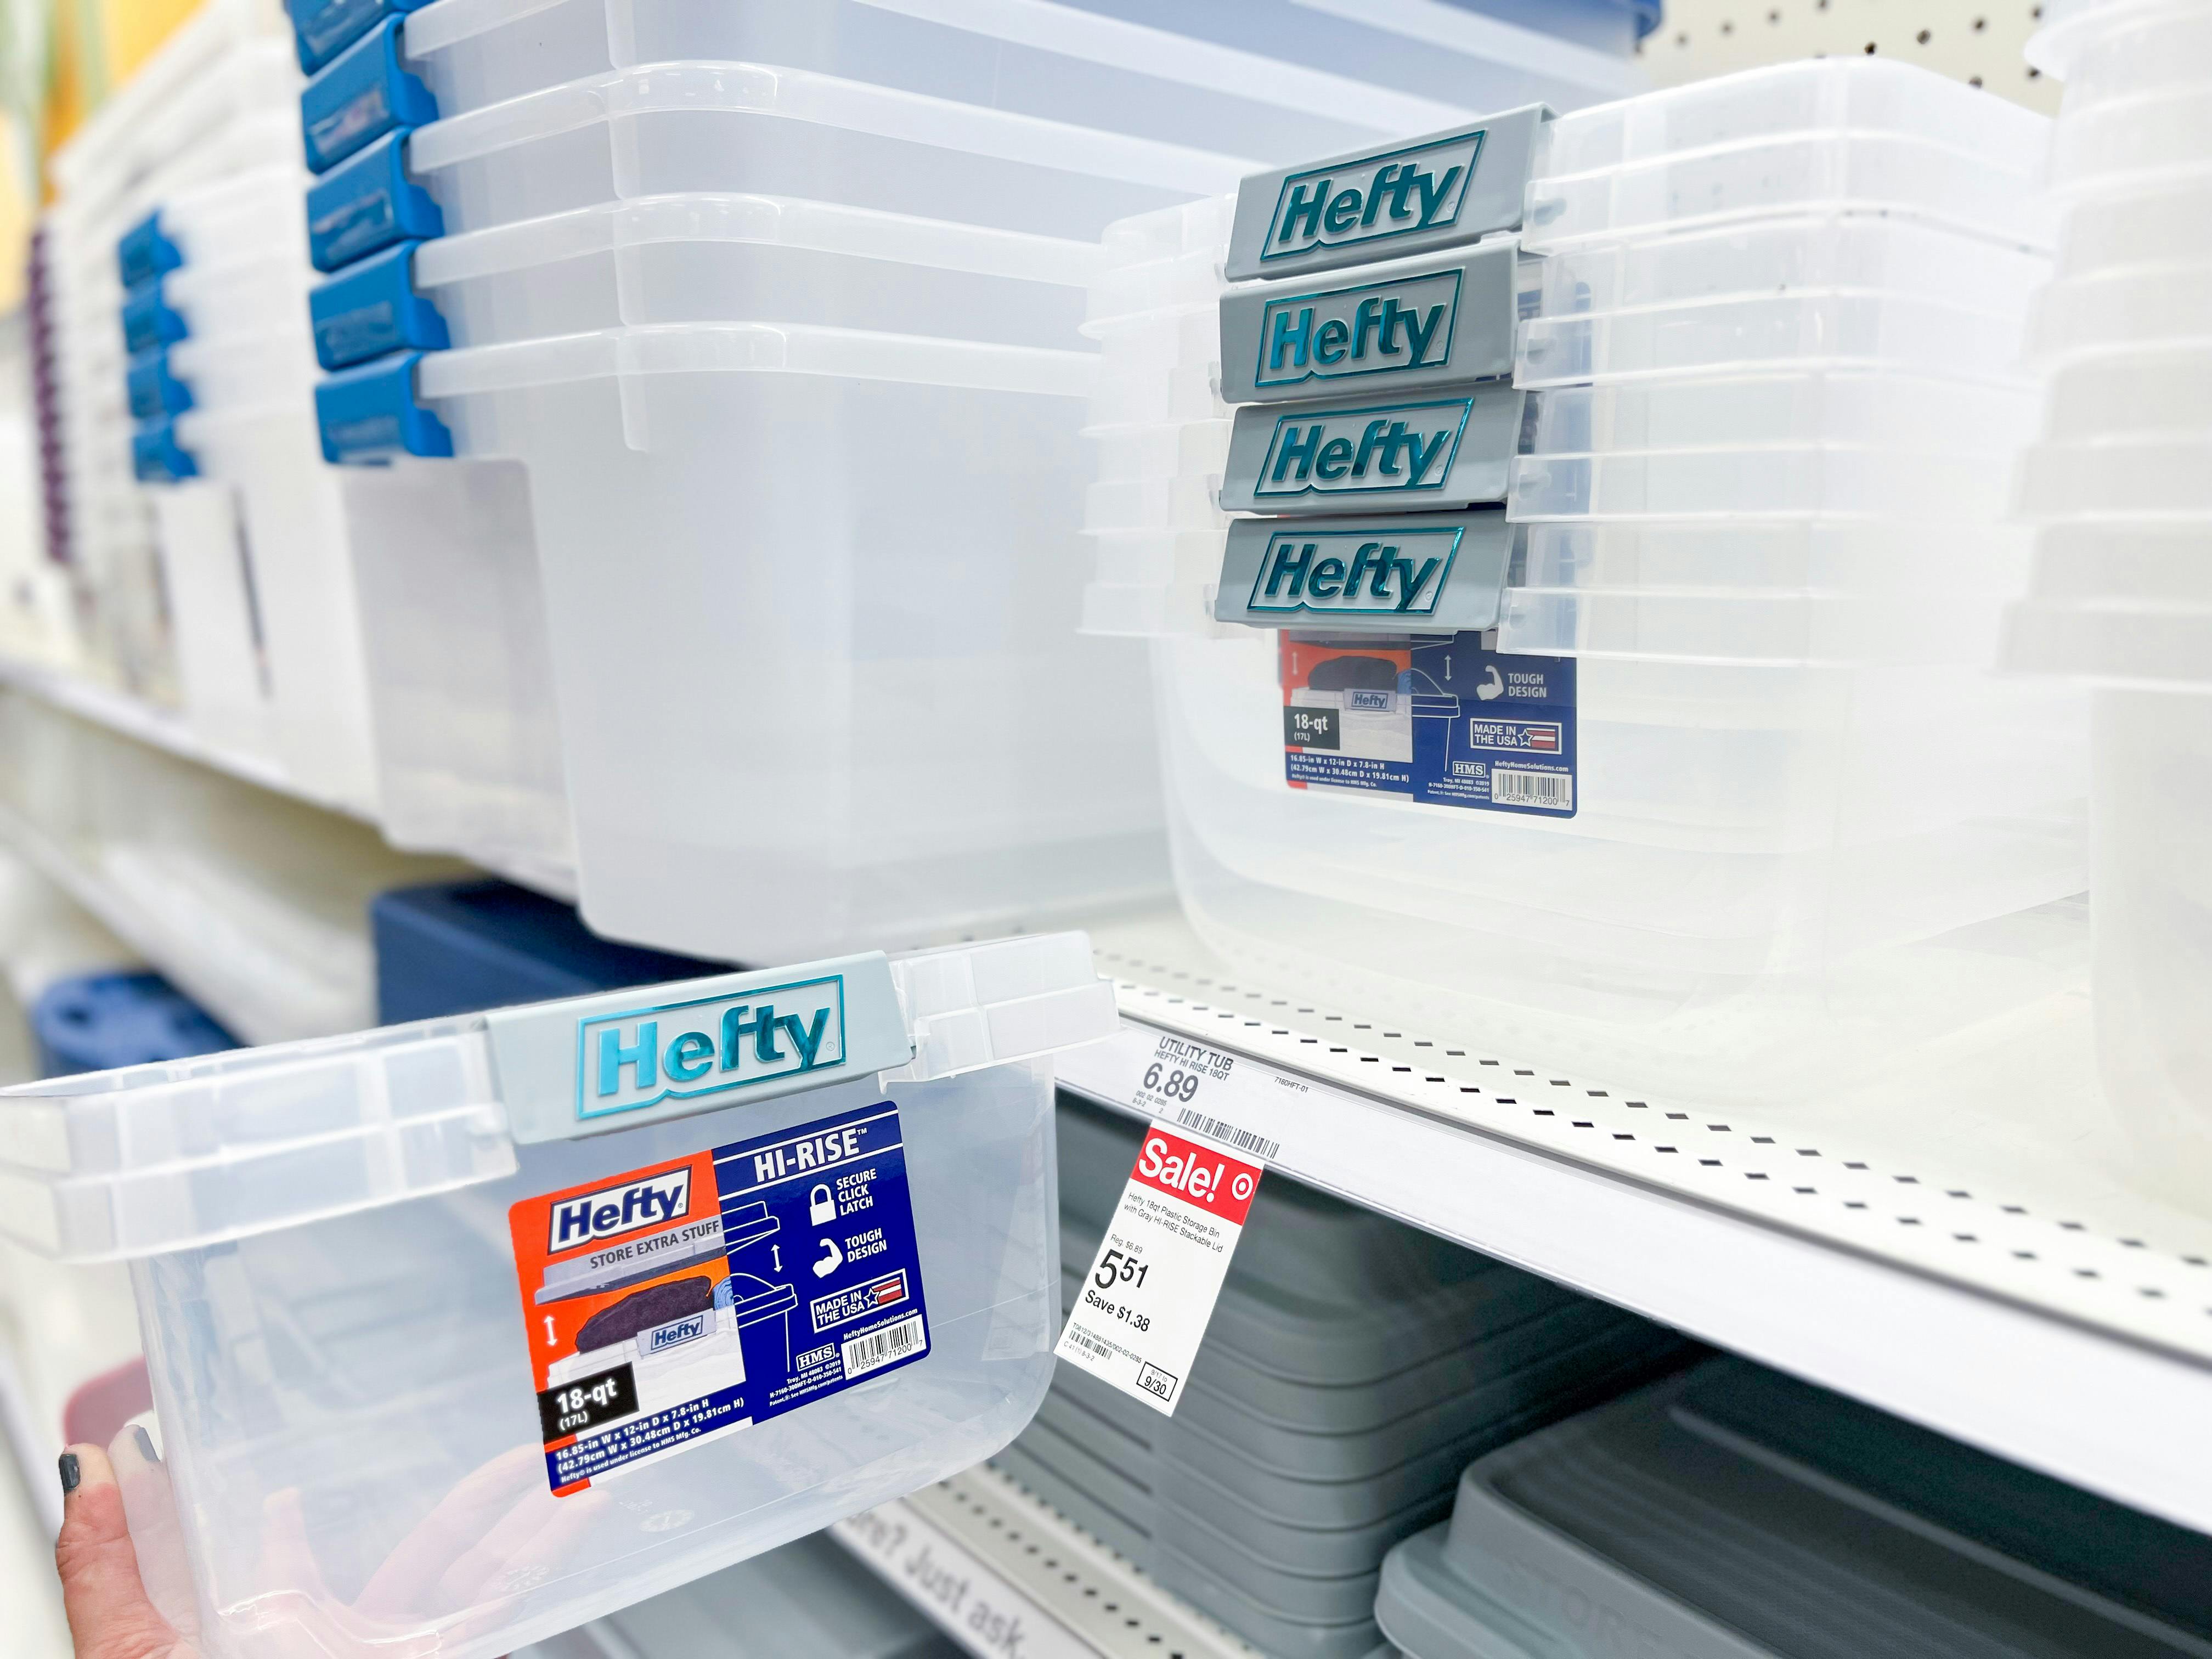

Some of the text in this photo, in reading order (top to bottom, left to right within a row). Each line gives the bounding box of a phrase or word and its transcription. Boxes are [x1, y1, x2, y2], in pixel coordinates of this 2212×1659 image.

[1278, 162, 1465, 242] Hefty
[1269, 295, 1447, 369] Hefty
[1271, 419, 1452, 487] Hefty
[1264, 542, 1442, 610] Hefty
[1508, 673, 1544, 685] TOUGH
[1353, 693, 1386, 709] Hefty
[1508, 686, 1547, 698] DESIGN
[1294, 714, 1328, 733] 18-qt
[1474, 724, 1516, 737] MADE IN
[1294, 732, 1311, 742] (17L)
[1475, 734, 1517, 747] THE USA
[1290, 755, 1314, 763] 16.85-in
[1454, 764, 1483, 776] HMS
[1494, 760, 1568, 772] HeftyHomeSolutions.com
[1291, 764, 1317, 772] (42.79cm
[1332, 768, 1357, 777] 30.48cm
[1373, 772, 1399, 781] 19.81cm
[1402, 775, 1409, 783] H)
[1507, 793, 1530, 803] 25947
[1533, 795, 1558, 806] 71200
[599, 1005, 830, 1097] Hefty
[1159, 1036, 1234, 1071] UTILITY TUB
[1154, 1049, 1229, 1081] HEFTY HI RISE 18QT
[1143, 1063, 1199, 1103] 6.89
[1274, 1076, 1308, 1093] 7160HFT-01
[836, 1168, 877, 1190] SECURE
[1138, 1137, 1225, 1203] Sale!
[838, 1183, 869, 1203] CLICK
[558, 1184, 684, 1243] Hefty
[839, 1196, 873, 1216] LATCH
[1128, 1192, 1220, 1238] Hefty 18qt Plastic Storage Bin
[844, 1228, 882, 1250] TOUGH
[1124, 1203, 1224, 1252] with Gray HI-RISE Stackable Lid
[590, 1220, 720, 1269] STORE EXTRA STUFF
[847, 1239, 887, 1263] DESIGN
[1110, 1233, 1143, 1255] Reg. $6.89
[816, 1290, 862, 1315] MADE IN
[817, 1301, 865, 1327] THE USA
[1085, 1290, 1150, 1333] Save $1.38
[654, 1320, 700, 1347] Hefty
[843, 1308, 918, 1341] HeftyHomeSolutions.com
[798, 1346, 833, 1368] HMS
[860, 1354, 884, 1369] 25947
[888, 1342, 912, 1361] 71200
[787, 1376, 800, 1384] Troy,
[1144, 1375, 1166, 1395] 9/30
[557, 1378, 617, 1414] 18-qt
[556, 1440, 599, 1461] 16.85-in
[602, 1434, 611, 1444] W
[624, 1421, 650, 1437] 12-in
[652, 1417, 659, 1426] D
[672, 1404, 700, 1420] 7.8-in
[702, 1398, 709, 1408] H
[559, 1411, 588, 1431] (17L)
[557, 1451, 605, 1474] (42.79cm
[608, 1443, 618, 1454] W
[630, 1426, 671, 1447] 30.48cm
[673, 1421, 681, 1430] D
[692, 1405, 731, 1424] 19.81cm
[733, 1397, 744, 1408] H)
[586, 1465, 592, 1473] is
[593, 1460, 608, 1471] used
[610, 1454, 629, 1468] under
[630, 1447, 652, 1458] license
[661, 1436, 675, 1446] HMS
[676, 1431, 691, 1442] Mfg.
[692, 1427, 701, 1436] Co.
[903, 1543, 970, 1614] Just
